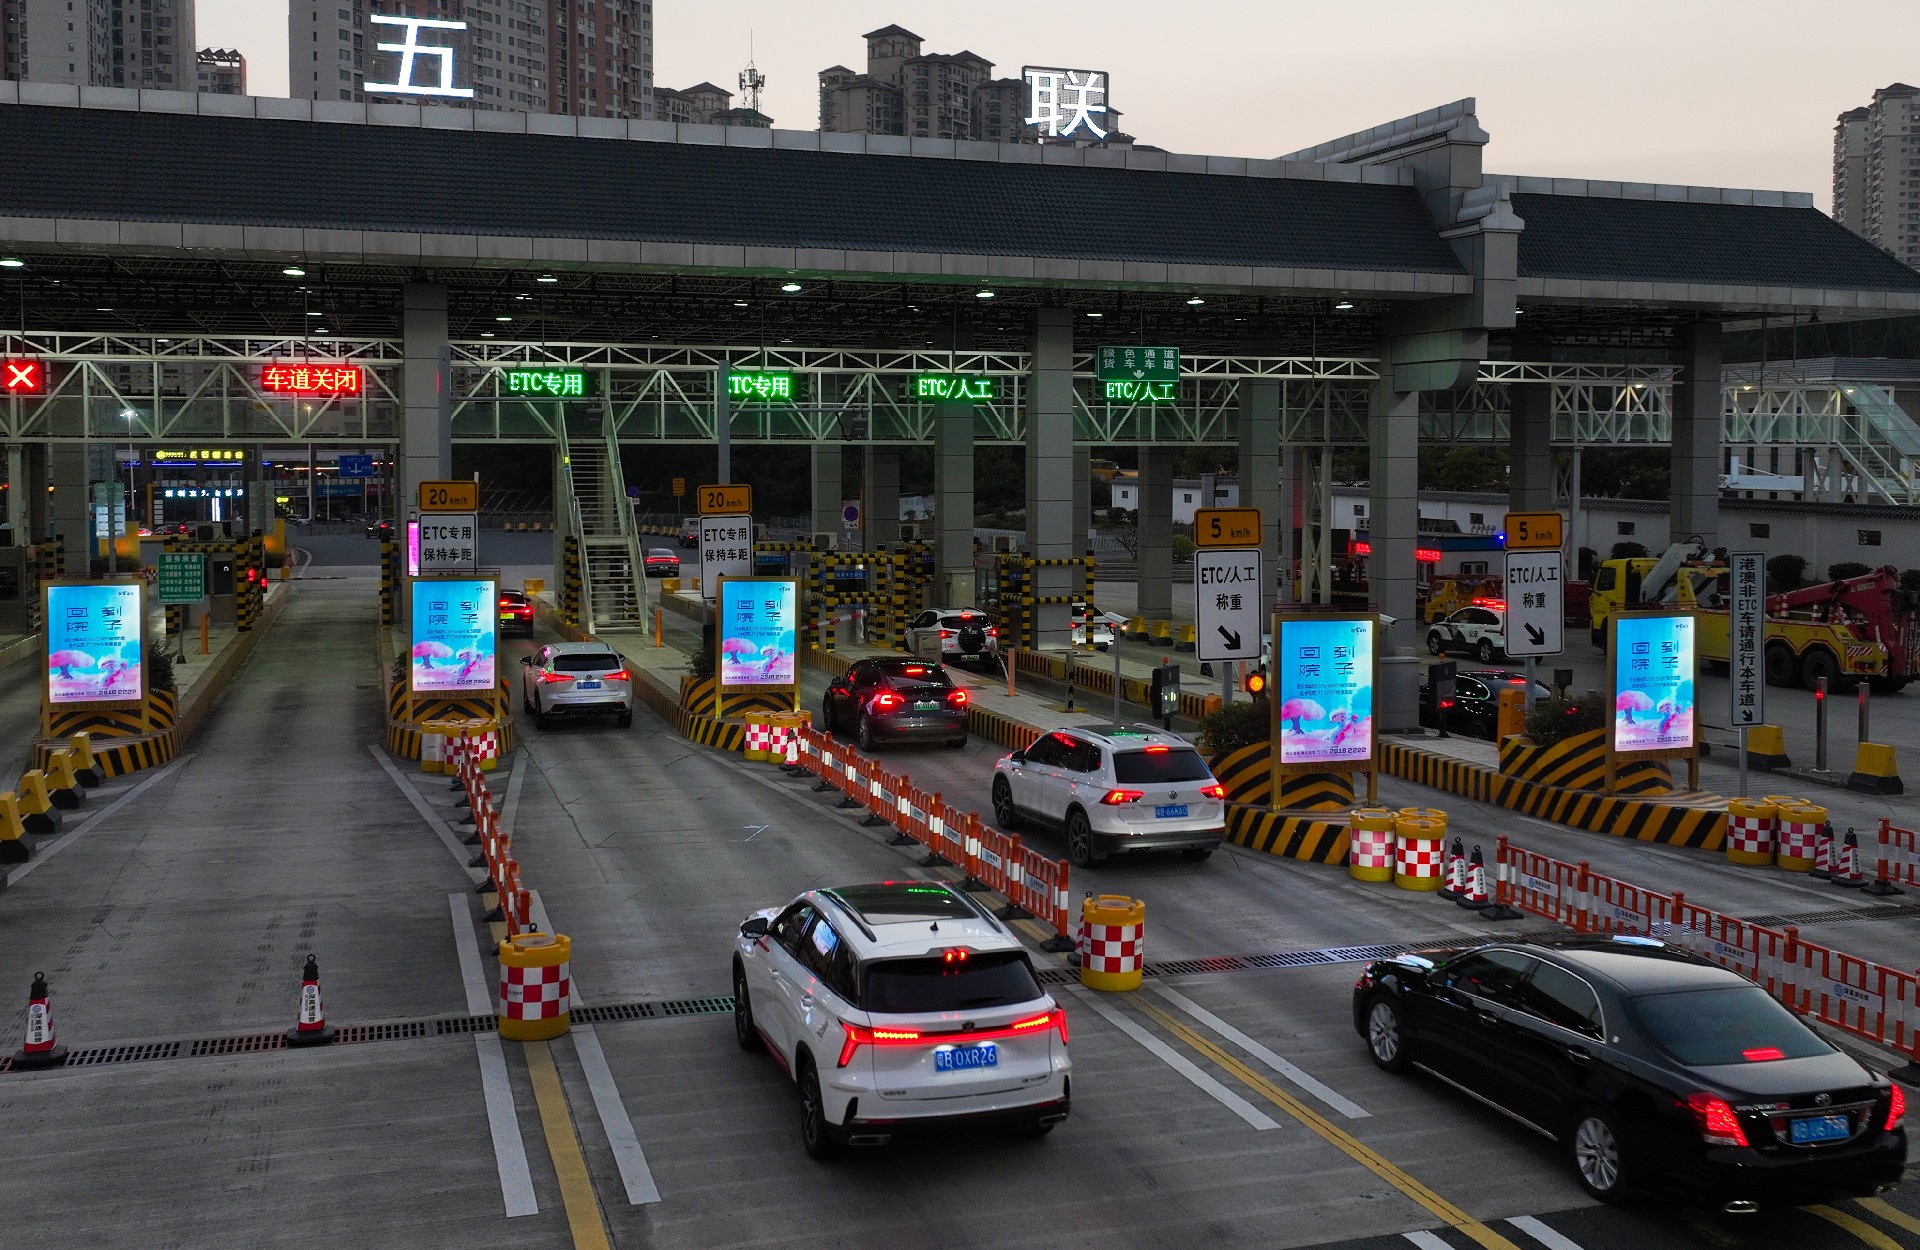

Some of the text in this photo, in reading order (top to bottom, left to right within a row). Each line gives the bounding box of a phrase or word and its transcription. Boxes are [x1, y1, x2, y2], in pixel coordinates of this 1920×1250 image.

[363, 14, 474, 98] 五
[1024, 70, 1108, 140] 联
[1102, 348, 1175, 358] 绿色通道
[1102, 359, 1175, 370] 货车车道
[263, 367, 357, 391] 车道关闭
[510, 372, 583, 395] ETC专用
[918, 378, 993, 399] ETC/人工
[1106, 381, 1175, 401] ETC/人工
[429, 488, 468, 505] 20 km/h
[708, 492, 743, 508] 20 km/h
[423, 526, 472, 541] ETC专用
[704, 527, 747, 542] ETC专用
[1211, 518, 1250, 538] 5 km/h
[1520, 522, 1553, 541] 5 km/h
[423, 547, 472, 562] 保持车距
[705, 548, 748, 562] 保持车距
[1201, 566, 1256, 584] ETC/人工
[1509, 566, 1558, 584] ETC/人工
[1216, 593, 1243, 611] 称重
[1523, 592, 1546, 608] 称重
